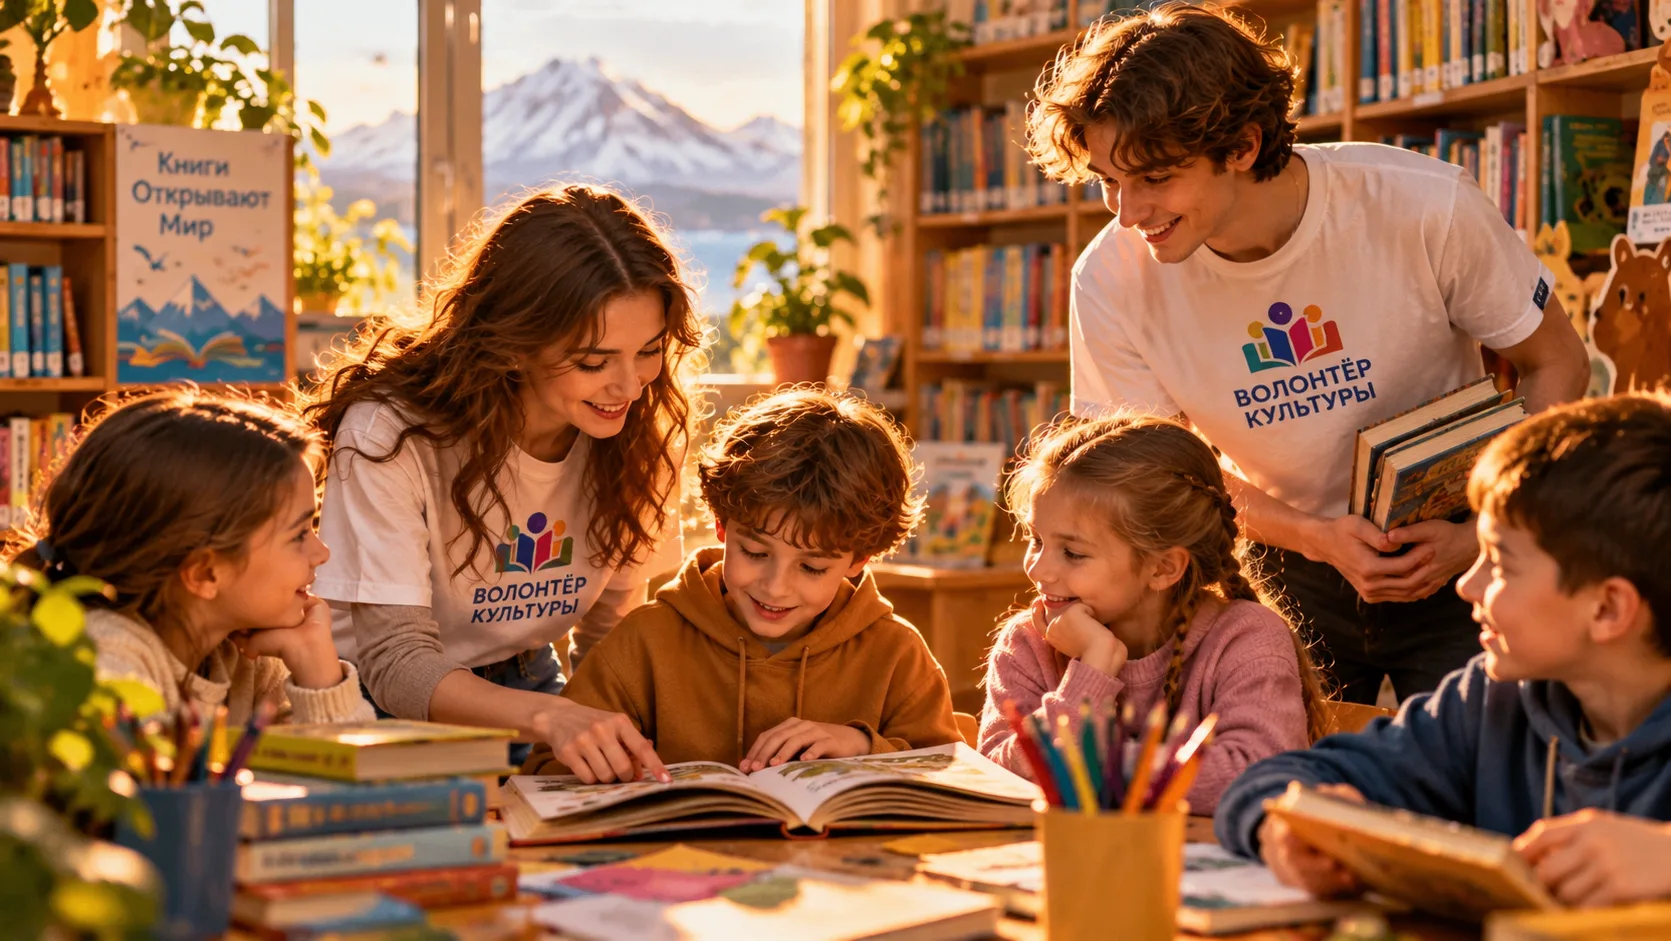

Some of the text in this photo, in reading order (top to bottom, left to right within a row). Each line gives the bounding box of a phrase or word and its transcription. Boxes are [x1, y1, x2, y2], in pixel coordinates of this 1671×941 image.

[158, 151, 230, 177] Книги
[132, 179, 271, 209] Открывают
[159, 213, 215, 242] Мир
[1233, 357, 1372, 407] ВОЛОНТЁР
[1244, 381, 1377, 429] КУЛЬТУРЫ
[472, 573, 587, 605] ВОЛОНТЁР
[471, 598, 579, 624] КУЛЬТУРЫ
